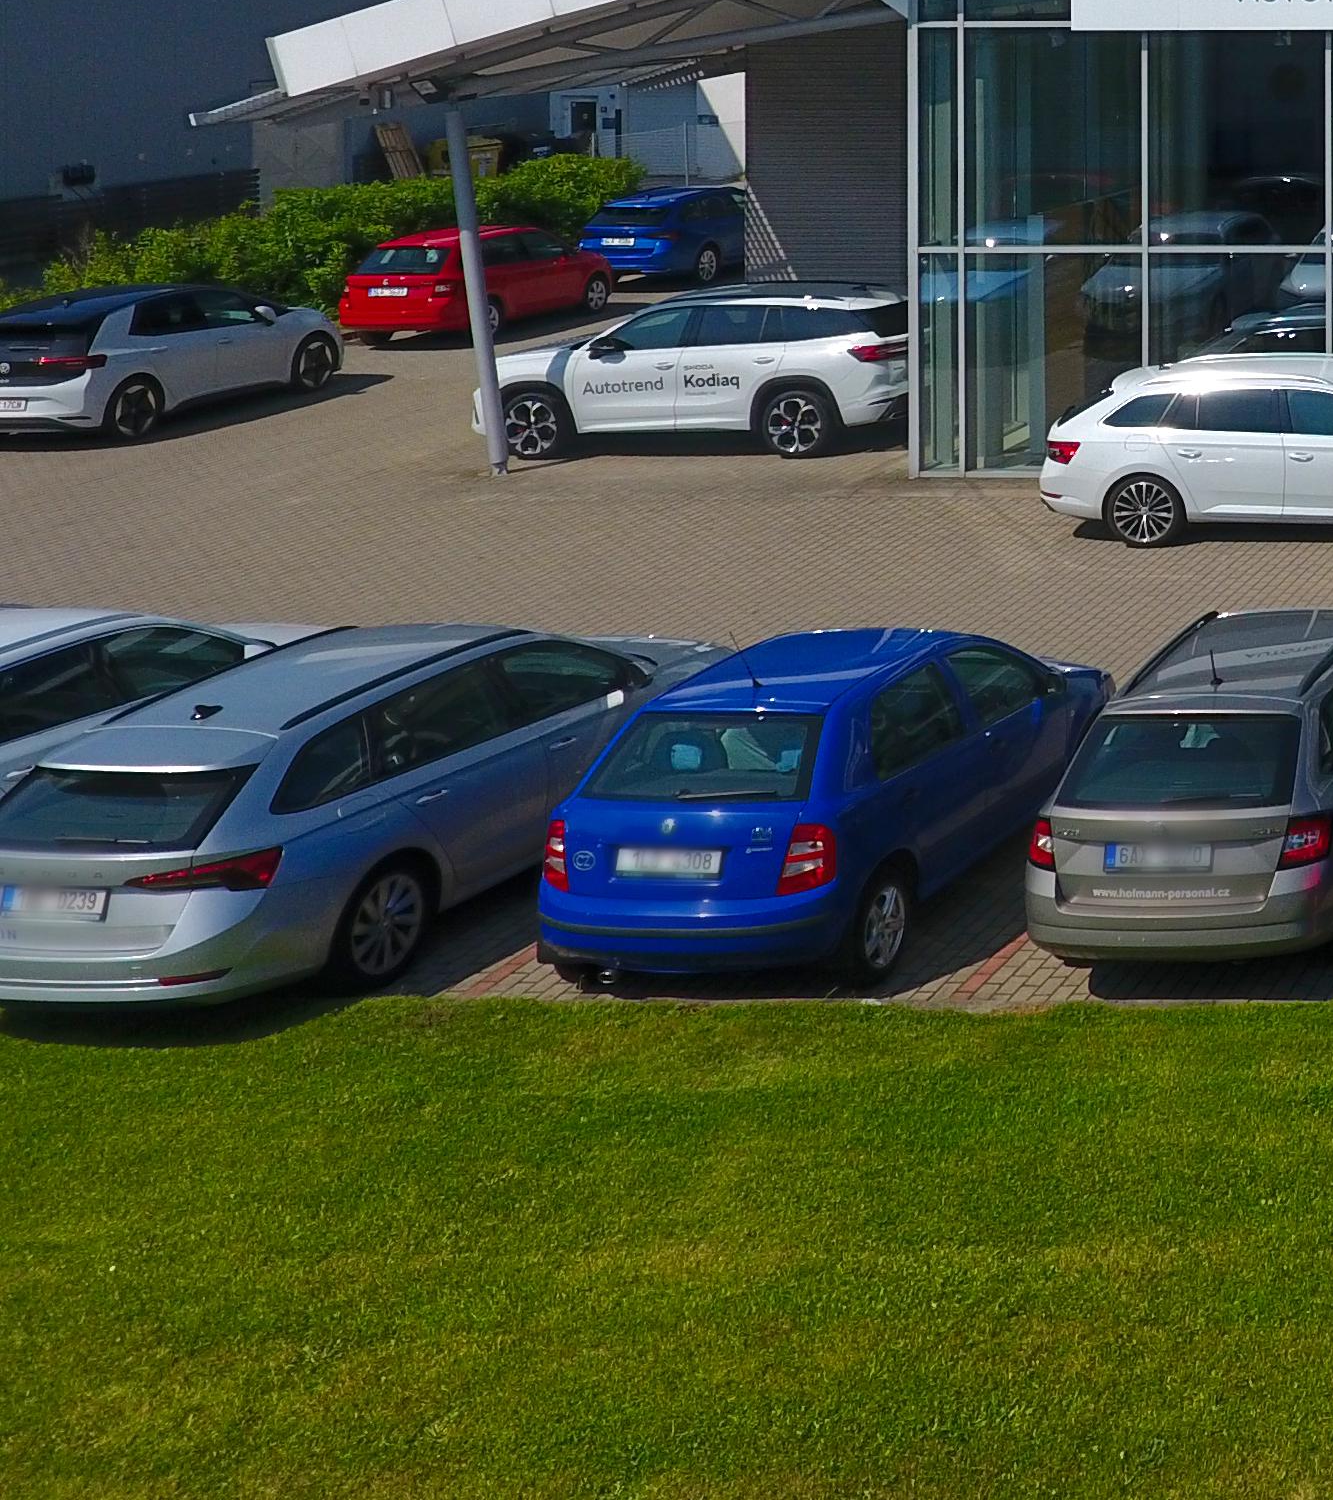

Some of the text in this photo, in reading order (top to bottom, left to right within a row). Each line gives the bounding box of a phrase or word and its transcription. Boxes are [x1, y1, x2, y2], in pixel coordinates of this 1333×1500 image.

[582, 376, 665, 396] Autotrend
[683, 373, 740, 390] Kodiaq
[575, 854, 590, 867] CZ
